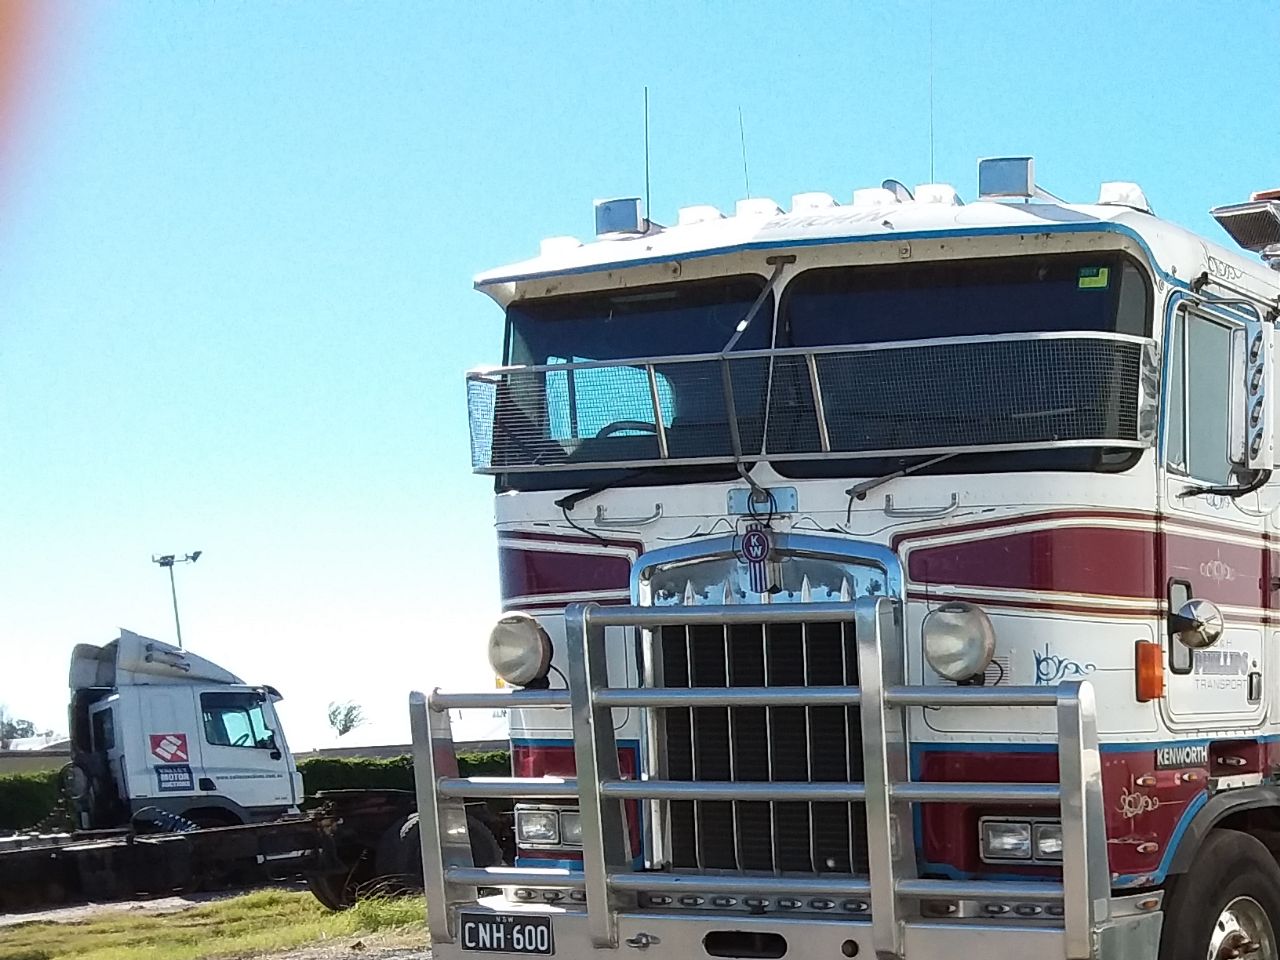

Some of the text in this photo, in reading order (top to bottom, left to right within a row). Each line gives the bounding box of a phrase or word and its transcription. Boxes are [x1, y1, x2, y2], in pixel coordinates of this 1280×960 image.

[1195, 678, 1247, 690] TRANSPORT
[1157, 746, 1208, 765] KENWORTH
[160, 773, 189, 781] MOTOR
